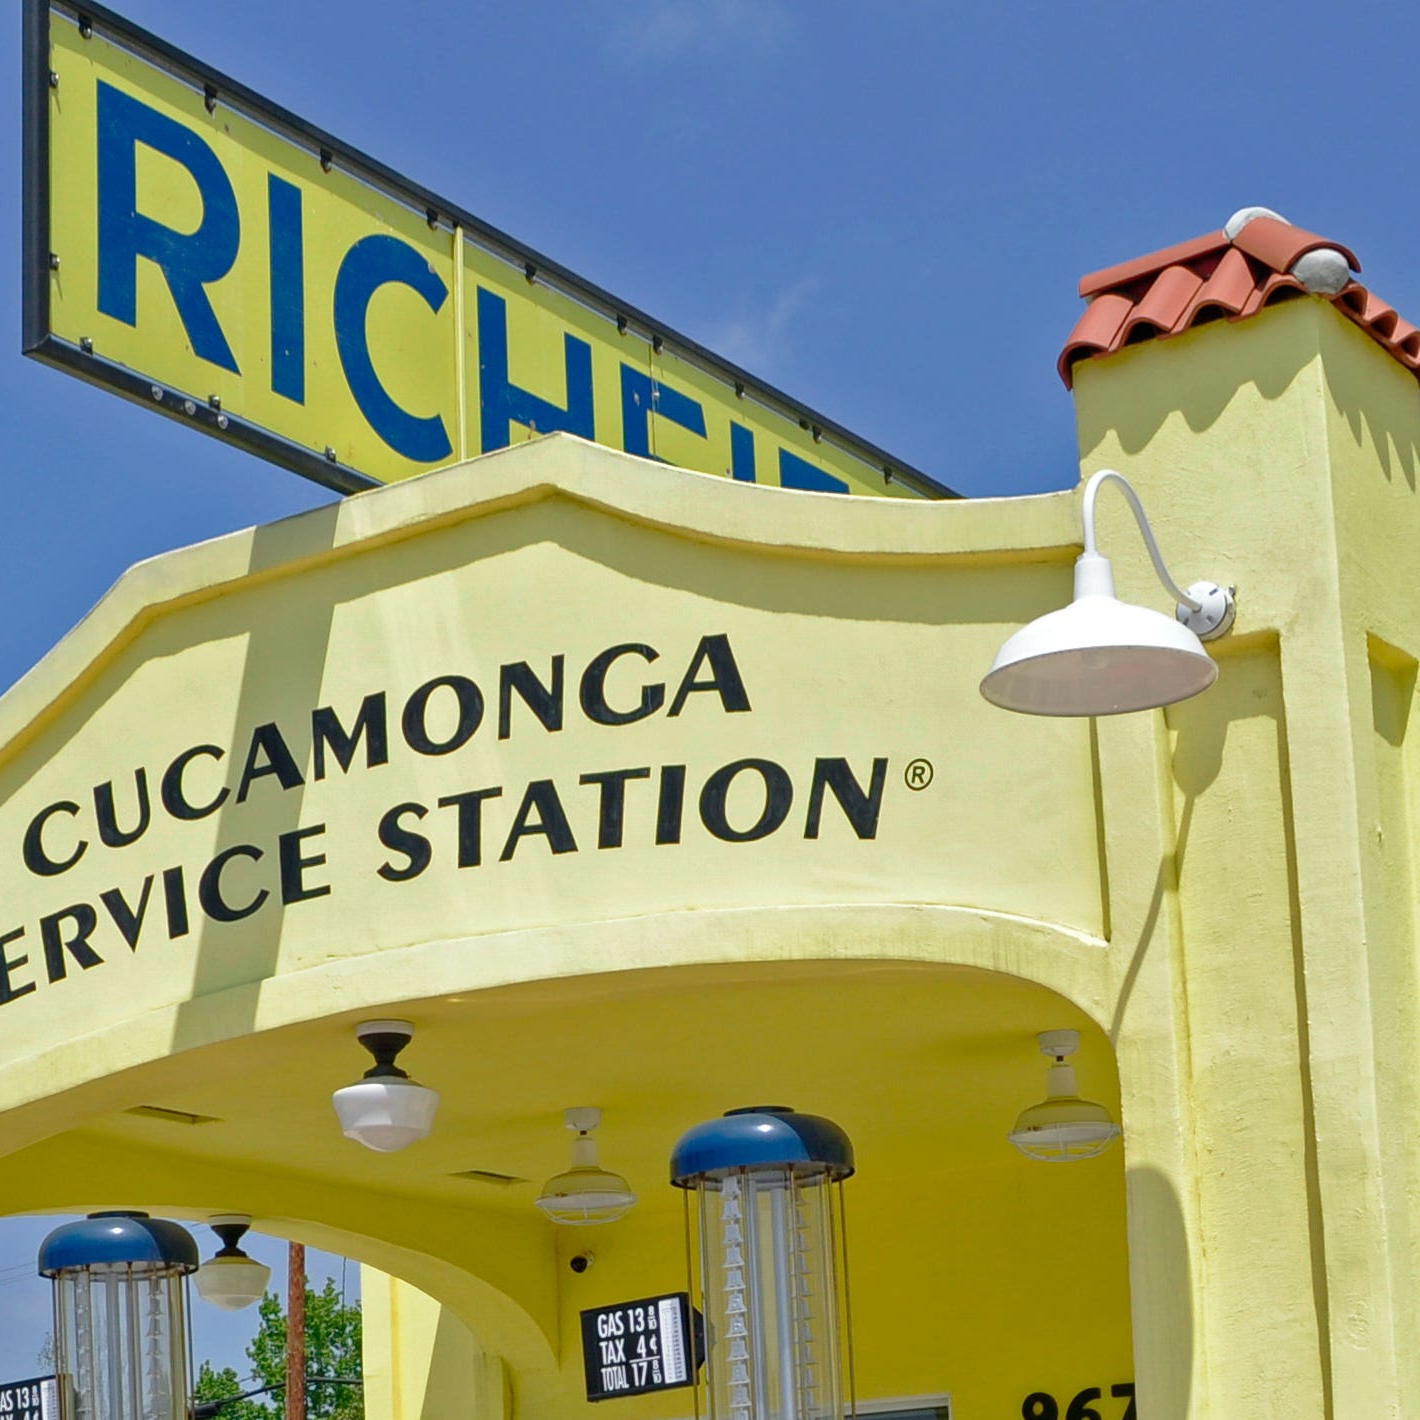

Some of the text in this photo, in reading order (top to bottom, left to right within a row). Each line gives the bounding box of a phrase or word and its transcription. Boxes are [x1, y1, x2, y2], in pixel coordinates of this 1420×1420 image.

[21, 633, 752, 877] CUCAMONGA
[379, 756, 888, 882] STATION
[597, 1311, 625, 1338] GAS
[627, 1307, 646, 1333] 13
[599, 1338, 626, 1365] TAX
[601, 1364, 629, 1392] TOTAL
[631, 1361, 648, 1387] 17
[15, 1386, 30, 1409] 13
